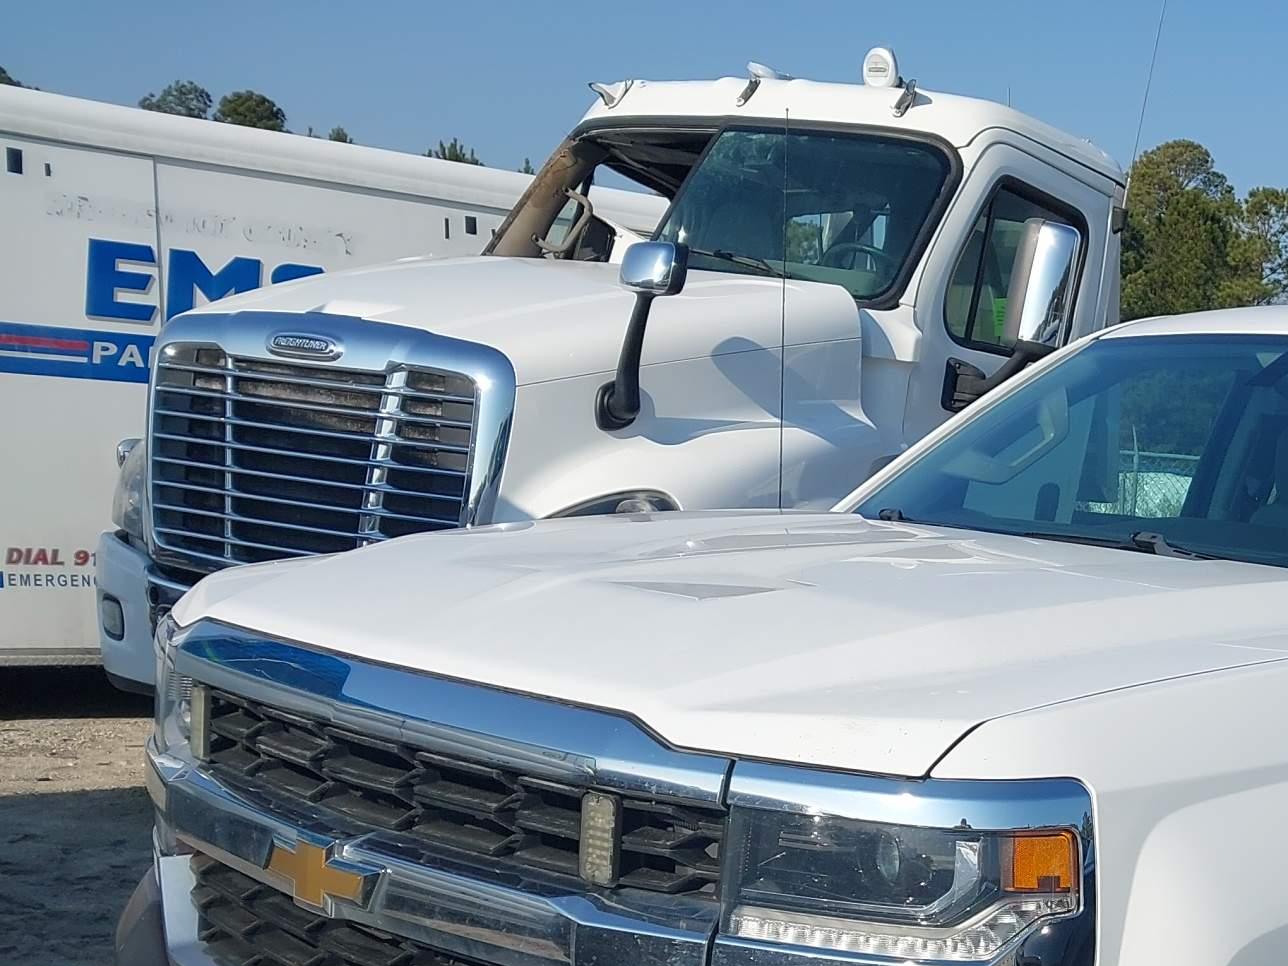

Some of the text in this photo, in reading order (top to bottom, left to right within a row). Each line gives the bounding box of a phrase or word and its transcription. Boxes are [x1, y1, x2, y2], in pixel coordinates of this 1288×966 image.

[92, 342, 151, 368] PA
[5, 547, 65, 566] DIAL
[8, 573, 97, 587] EMERGEN
